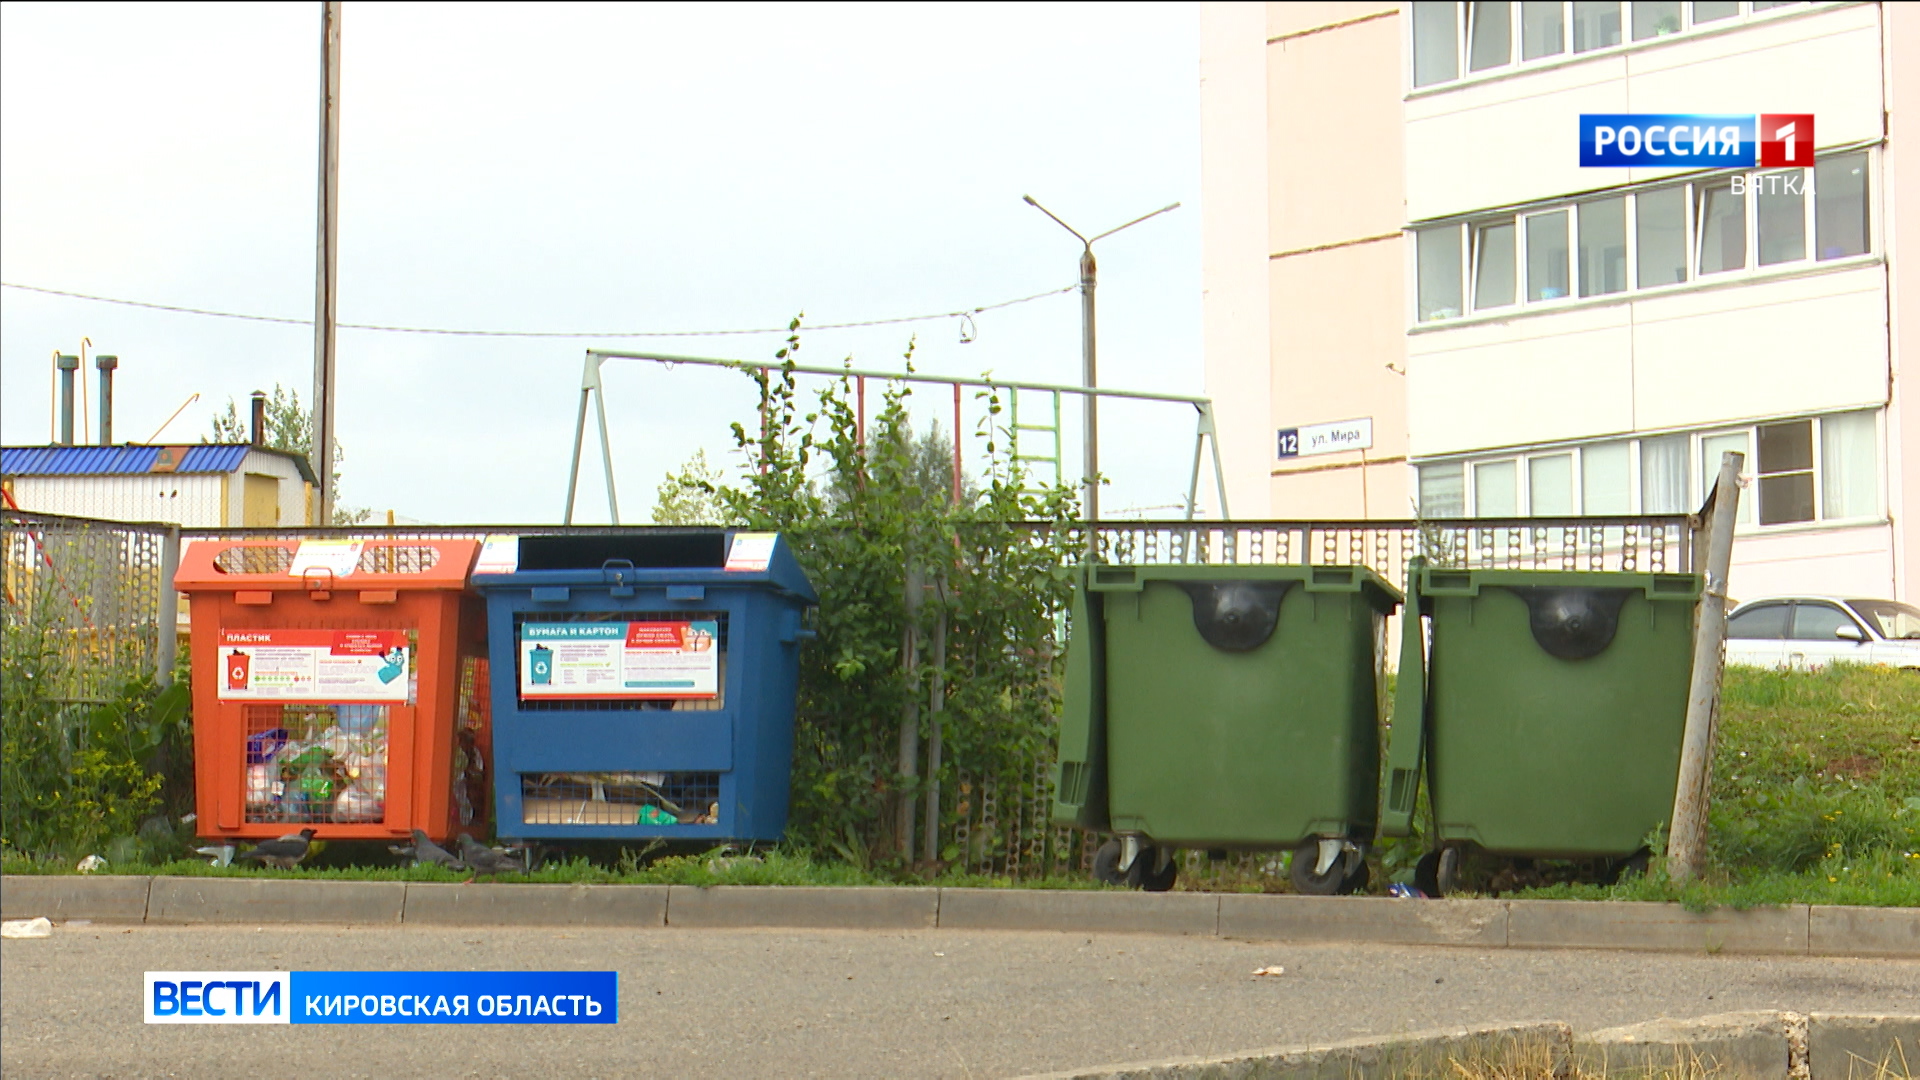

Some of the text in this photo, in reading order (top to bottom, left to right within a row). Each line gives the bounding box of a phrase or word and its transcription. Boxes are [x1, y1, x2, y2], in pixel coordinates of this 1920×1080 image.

[1280, 429, 1360, 454] 12 ул. Мира
[528, 627, 619, 636] БУМАГА И КАРТОН
[226, 633, 272, 642] ПЛАСТИК
